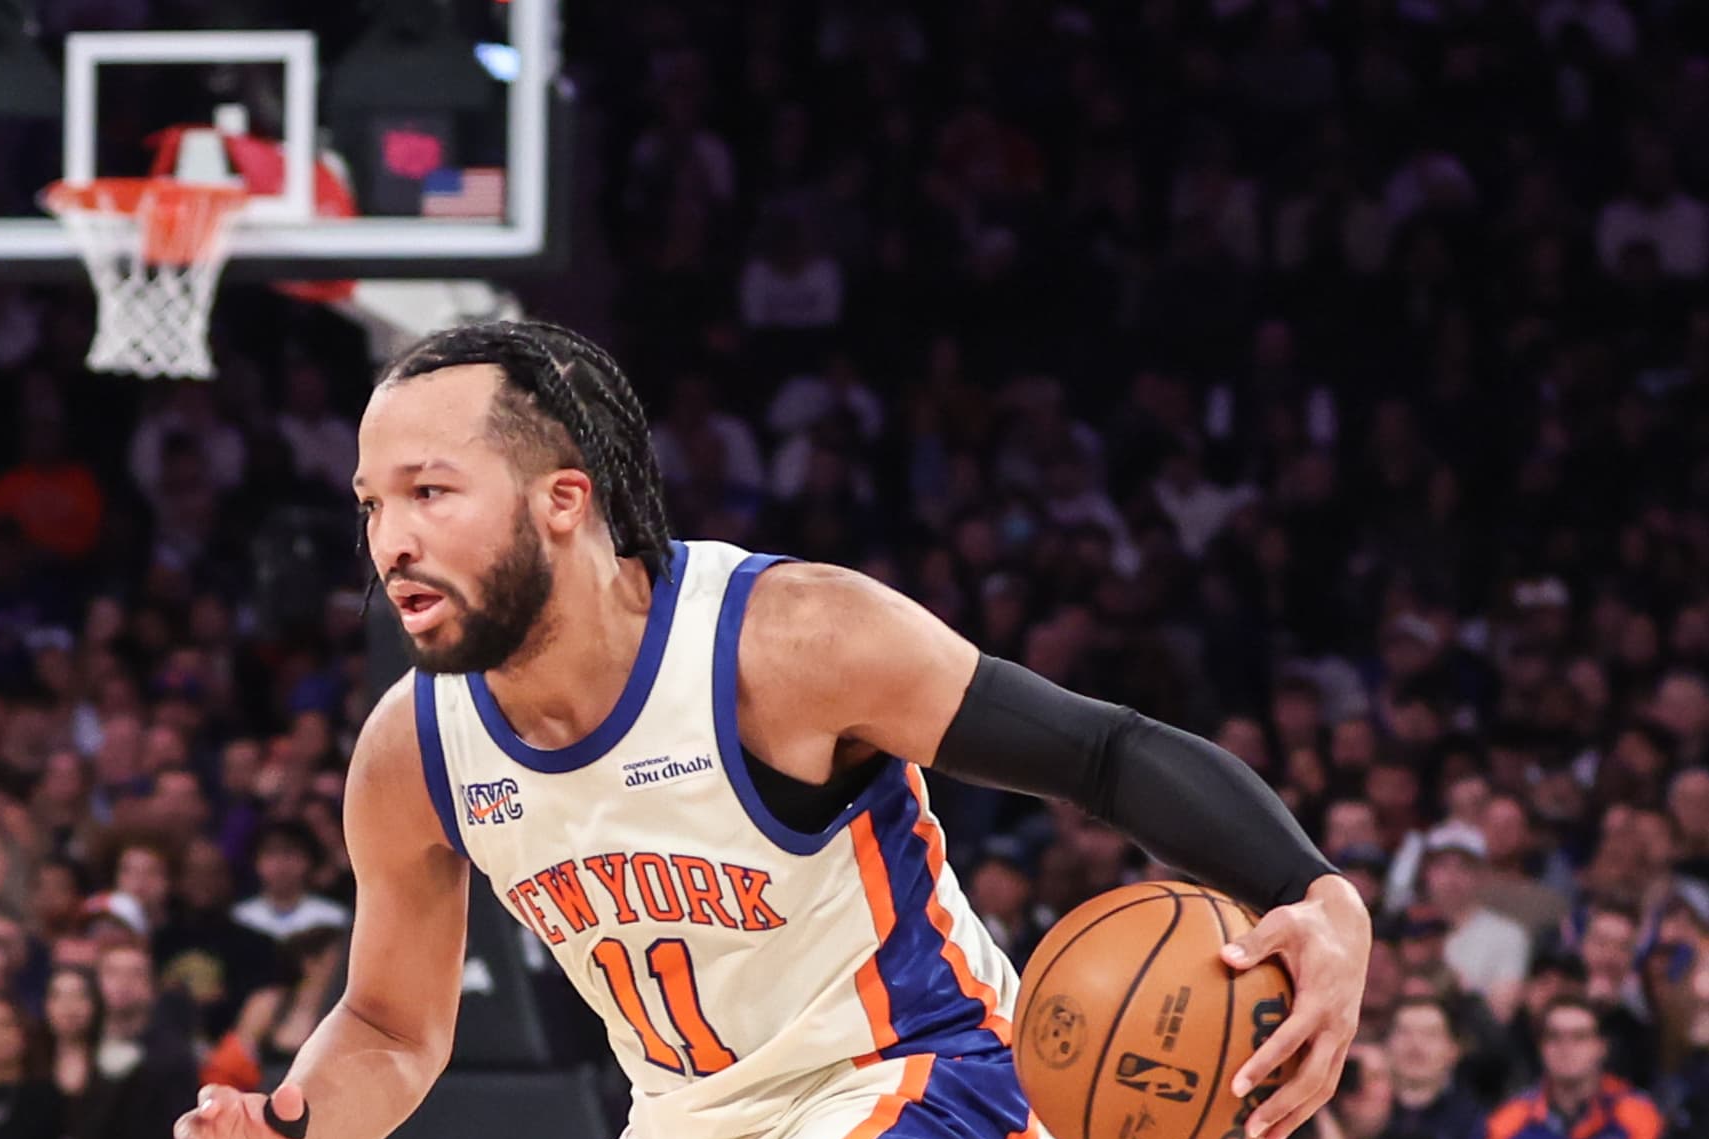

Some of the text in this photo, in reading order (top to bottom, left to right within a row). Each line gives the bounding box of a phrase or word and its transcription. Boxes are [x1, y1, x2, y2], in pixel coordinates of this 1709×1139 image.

[622, 755, 670, 771] experience
[625, 754, 713, 787] abu dhabi
[460, 778, 523, 825] NYC
[583, 852, 787, 932] YORK
[591, 937, 739, 1077] 11
